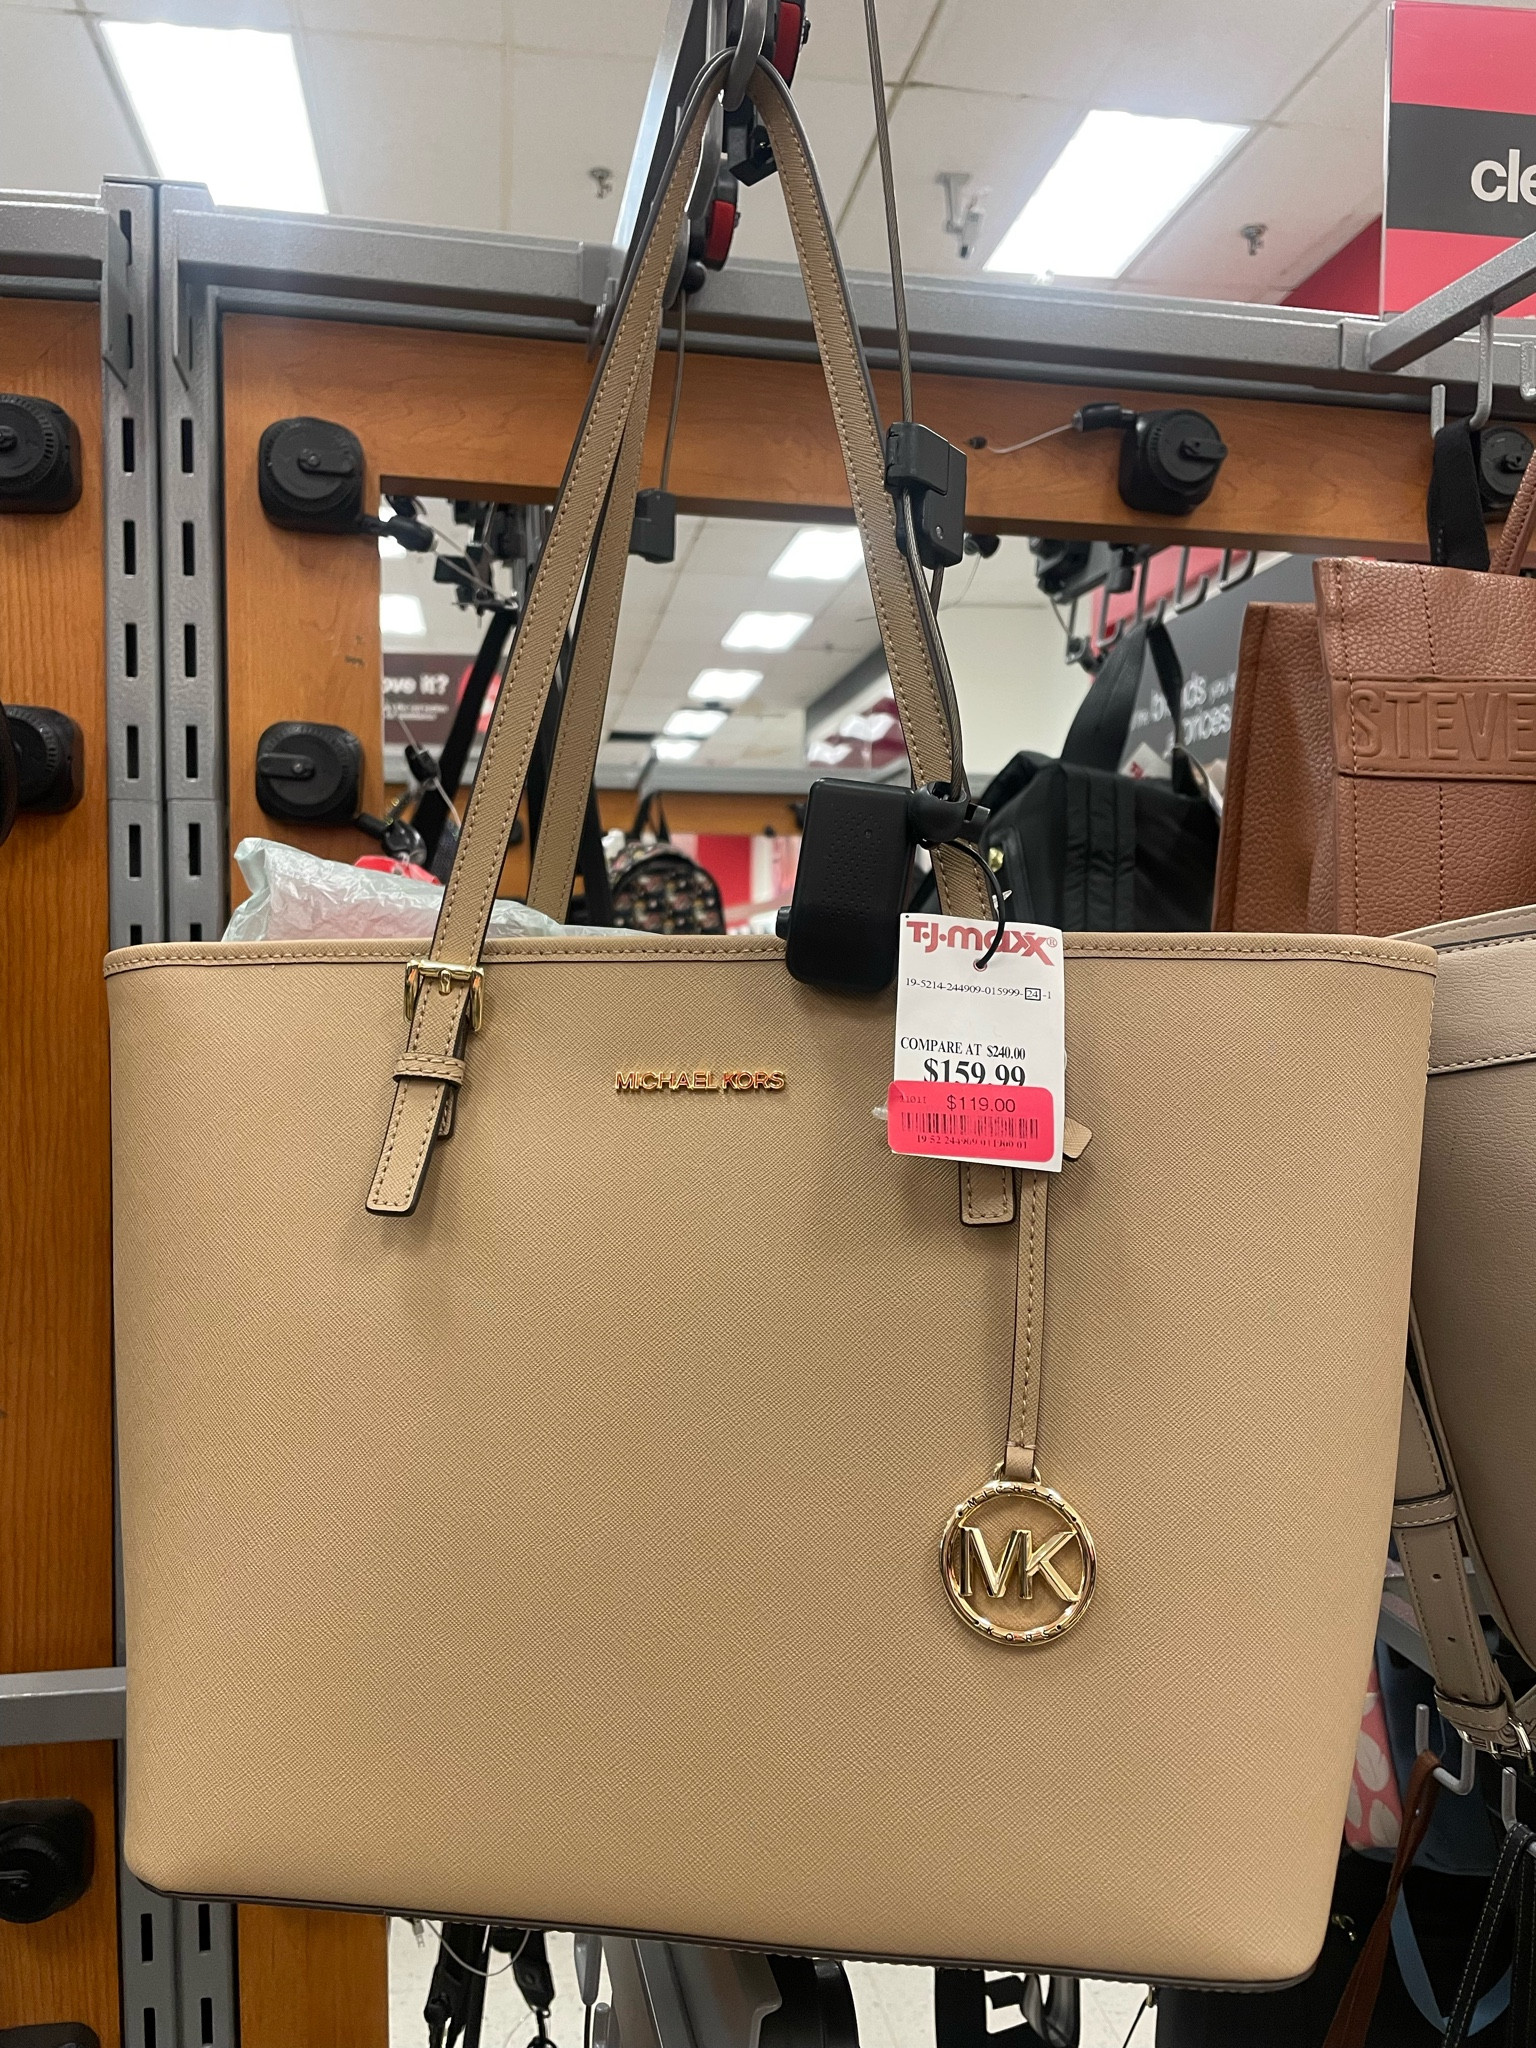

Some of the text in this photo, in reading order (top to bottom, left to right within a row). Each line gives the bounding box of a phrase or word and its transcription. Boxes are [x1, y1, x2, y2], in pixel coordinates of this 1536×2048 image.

[1347, 688, 1536, 762] STEVE
[900, 1036, 1026, 1060] COMPARE AT $240.00
[615, 1071, 785, 1090] MICHAEL KORS
[946, 1094, 1016, 1113] $119.00
[917, 1134, 927, 1143] 19
[930, 1135, 941, 1144] 52
[957, 1526, 1081, 1603] MK
